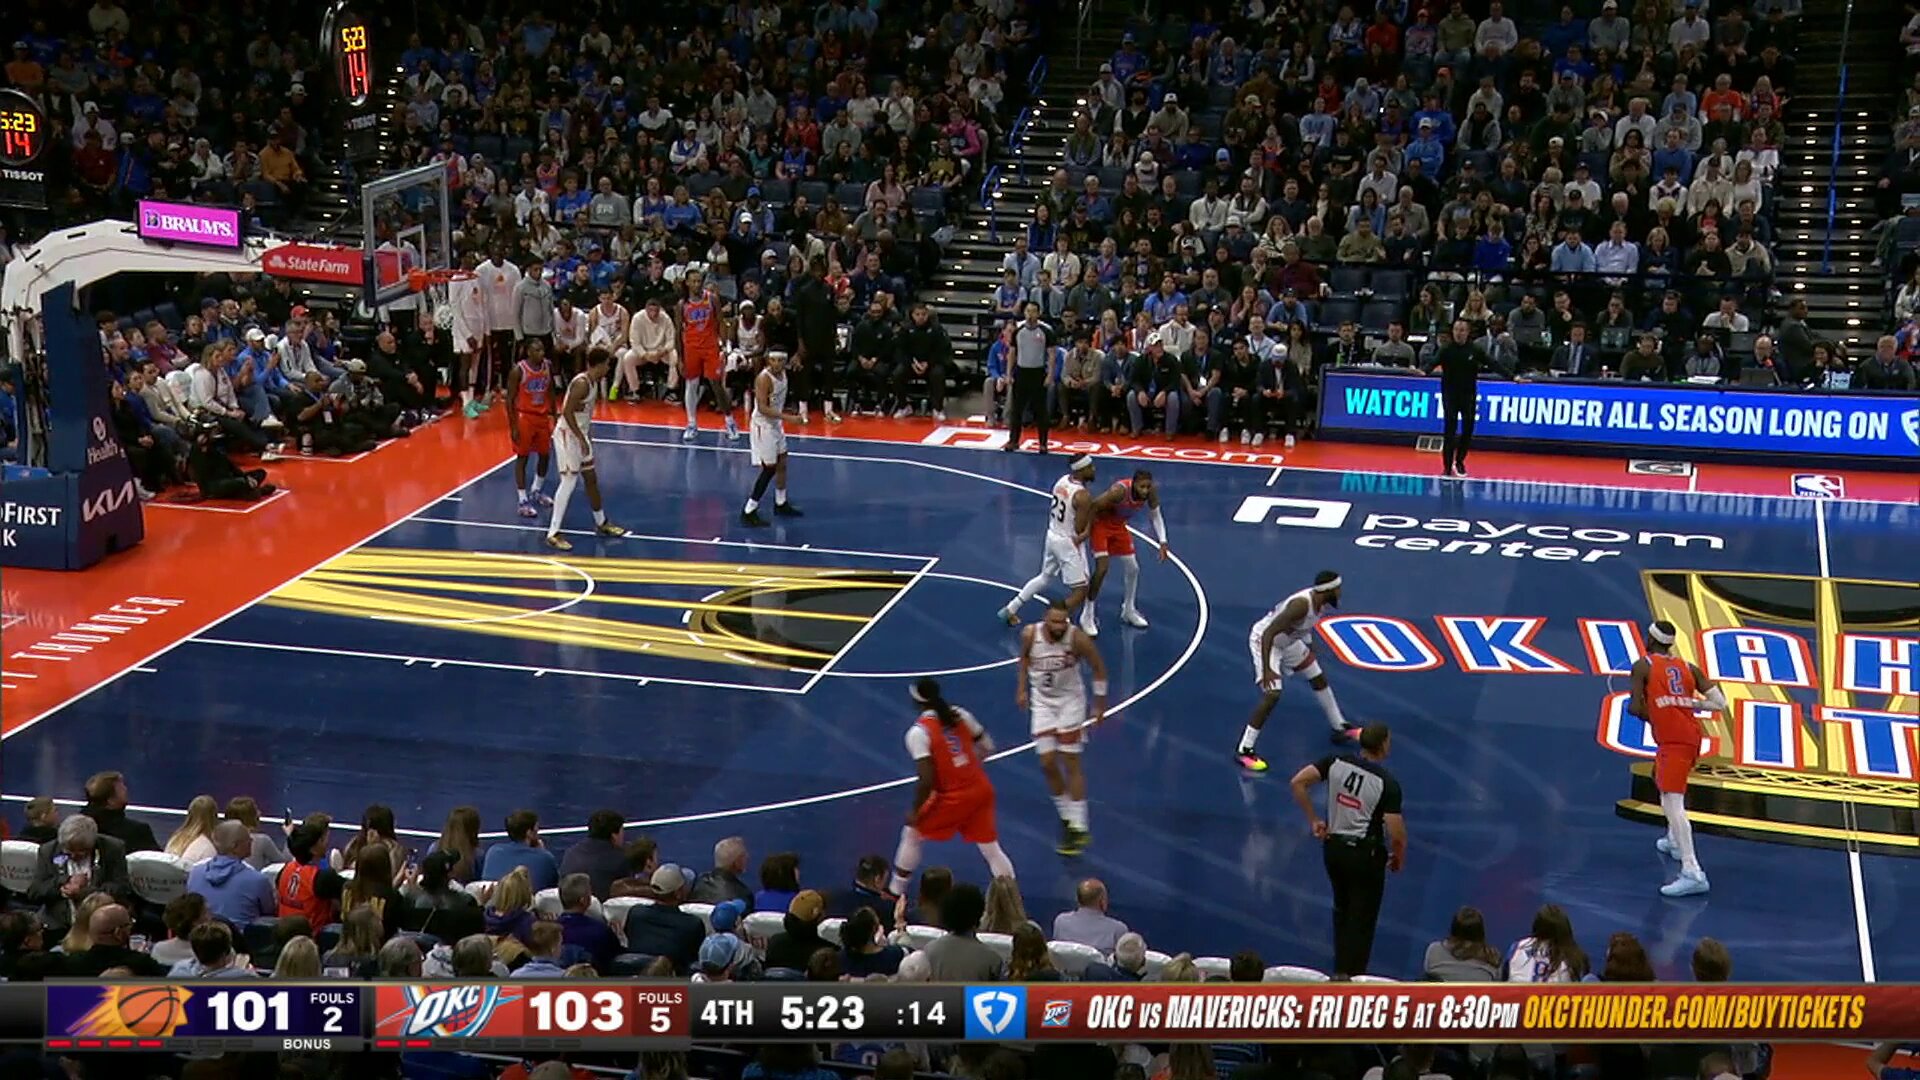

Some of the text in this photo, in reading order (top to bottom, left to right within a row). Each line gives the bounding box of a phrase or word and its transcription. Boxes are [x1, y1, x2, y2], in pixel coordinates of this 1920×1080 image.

[347, 52, 369, 97] 14
[5, 131, 31, 156] 14
[2, 169, 44, 182] TISSOT
[1345, 387, 1430, 418] WATCH
[1487, 395, 1602, 427] THUNDER
[1607, 401, 1654, 430] ALL
[1659, 403, 1762, 434] SEASON
[1769, 408, 1842, 439] LONG
[1848, 411, 1889, 440] ON
[0, 501, 61, 526] FIRST
[83, 480, 134, 522] KIA
[1050, 495, 1066, 523] 23
[1362, 513, 1725, 550] paycom
[1354, 534, 1622, 563] center
[10, 596, 186, 661] THUNDER
[1665, 666, 1684, 696] 2
[1343, 770, 1365, 797] 41
